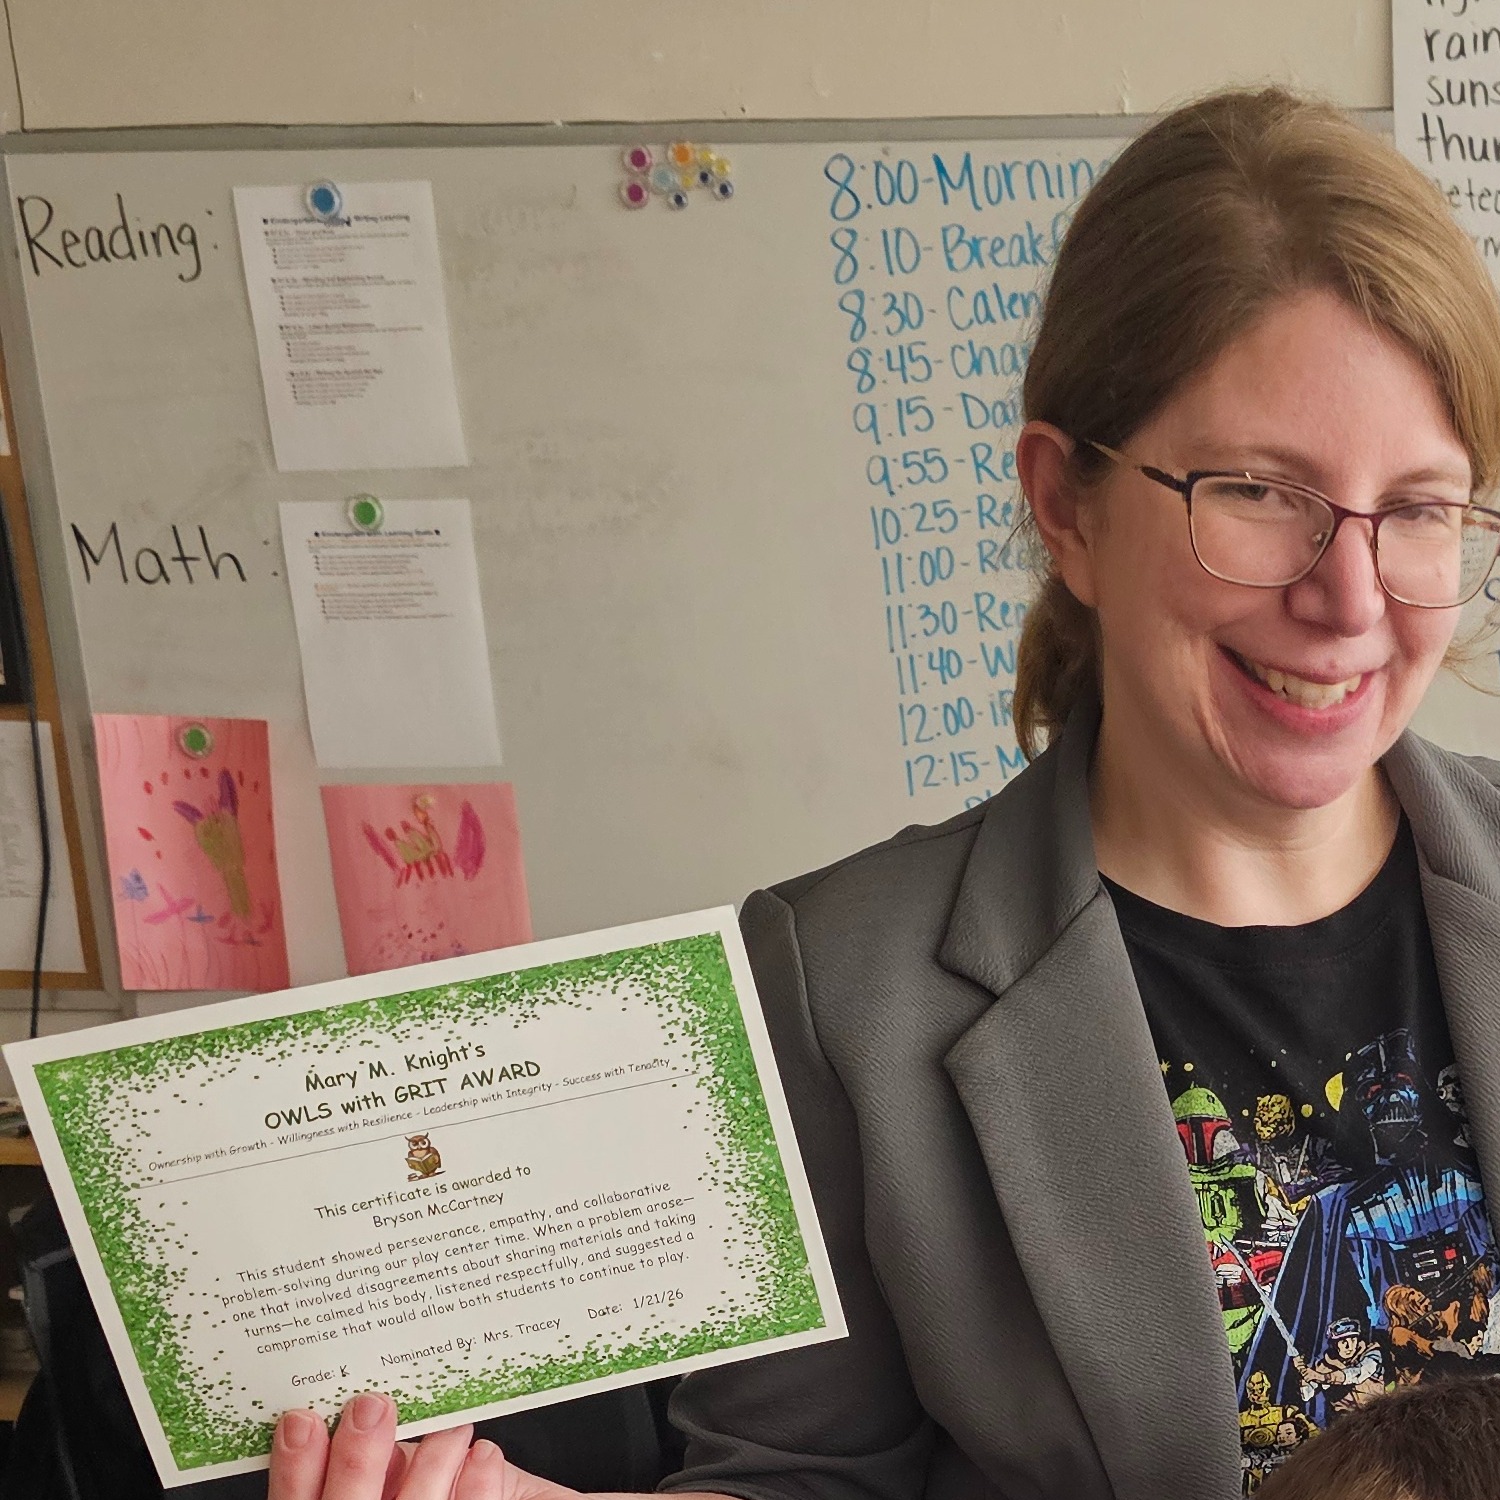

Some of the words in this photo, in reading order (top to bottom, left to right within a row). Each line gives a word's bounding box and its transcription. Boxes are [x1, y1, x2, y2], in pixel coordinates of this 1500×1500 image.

[263, 1101, 333, 1130] OWLS
[339, 1089, 387, 1115] with
[393, 1076, 448, 1104] GRIT
[459, 1059, 541, 1091] AWARD
[304, 1069, 358, 1093] Mary
[367, 1059, 396, 1080] M.
[402, 1040, 486, 1073] Knight's
[147, 1152, 202, 1172] Ownership
[202, 1146, 228, 1160] with
[228, 1138, 268, 1156] Growth
[275, 1126, 336, 1146] Willingness
[336, 1118, 360, 1133] with
[361, 1110, 413, 1128] Resilience
[422, 1096, 479, 1116] Leadership
[479, 1089, 504, 1104] with
[504, 1081, 553, 1099] Integrity
[561, 1071, 602, 1087] Success
[602, 1064, 626, 1079] with
[625, 1056, 671, 1073] Tenacity
[234, 1267, 268, 1283] This
[271, 1255, 326, 1277] student
[330, 1240, 383, 1264] showed
[386, 1223, 486, 1256] perseverance,
[488, 1208, 552, 1230] empathy,
[554, 1197, 579, 1215] and
[582, 1181, 671, 1209] collaborative
[371, 1208, 424, 1229] Bryson
[426, 1191, 504, 1217] McCartney
[290, 1368, 336, 1387] Grade:
[338, 1363, 351, 1378] K
[379, 1338, 453, 1367] Nominated
[455, 1335, 477, 1353] By:
[482, 1328, 514, 1344] Mrs.
[513, 1317, 561, 1335] Tracey
[586, 1302, 623, 1320] Date:
[632, 1286, 684, 1309] 1/21/26
